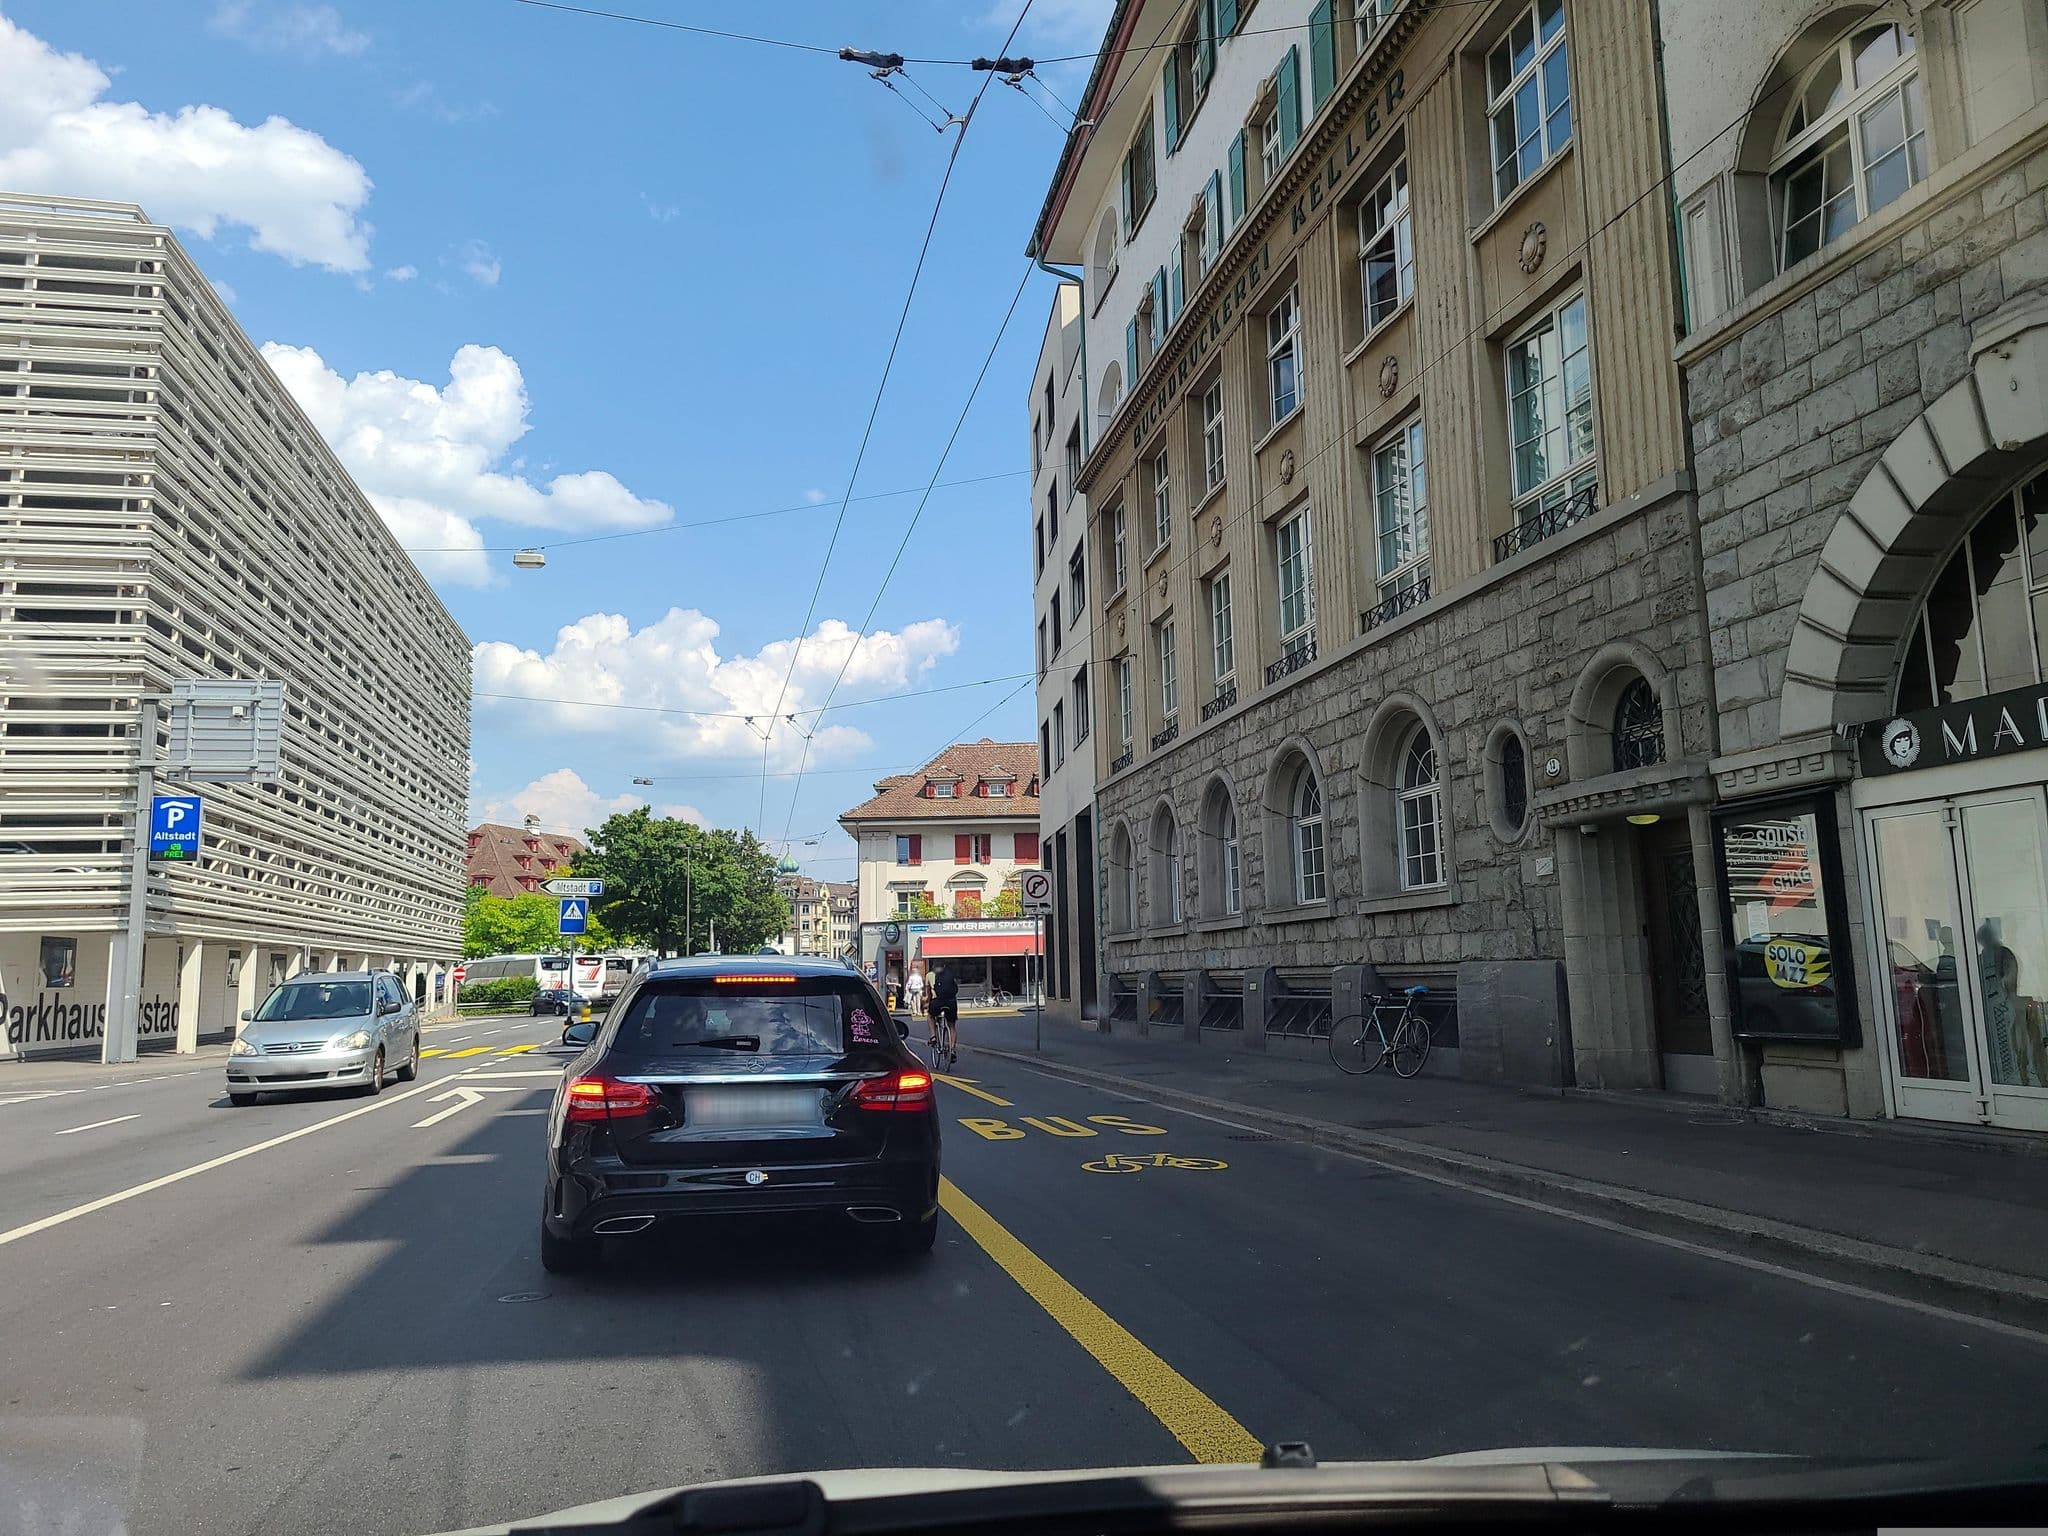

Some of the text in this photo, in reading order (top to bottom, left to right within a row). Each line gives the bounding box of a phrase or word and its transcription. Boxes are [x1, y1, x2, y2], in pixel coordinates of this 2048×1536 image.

[1133, 69, 1405, 449] BUCHDRUCKEREI KELLER
[154, 831, 196, 841] Altstadt
[164, 850, 184, 858] FREI
[1768, 945, 1807, 966] SOLO
[957, 1115, 1169, 1141] BUS
[749, 1172, 761, 1182] CH
